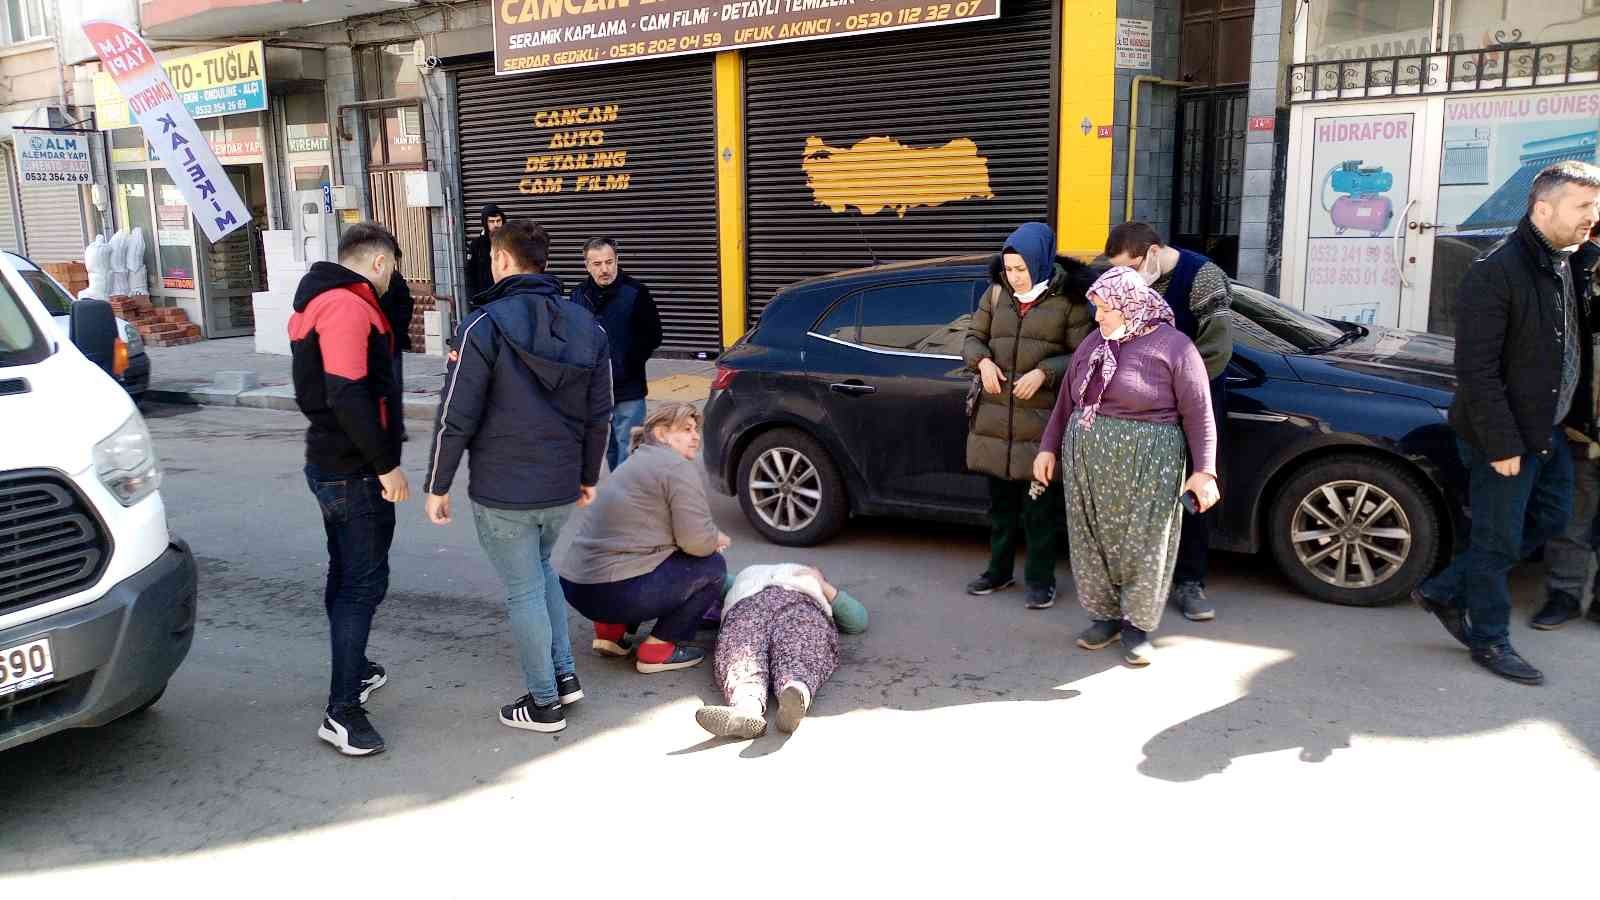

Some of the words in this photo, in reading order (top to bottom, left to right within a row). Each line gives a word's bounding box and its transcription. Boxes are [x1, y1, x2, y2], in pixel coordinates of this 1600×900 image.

[565, 20, 627, 42] KAPLAMA
[639, 13, 669, 31] CAM
[673, 7, 709, 27] FİLMİ
[721, 0, 780, 21] DETAYLI
[783, 0, 854, 13] TEMİZ
[504, 55, 549, 71] SERDAR
[610, 42, 644, 58] 0536
[648, 37, 675, 53] 202
[680, 35, 700, 49] 04
[702, 33, 722, 47] 59
[734, 25, 774, 44] UFUK
[779, 18, 832, 38] AKINCI
[845, 11, 892, 30] 0530
[897, 8, 922, 25] 112
[926, 4, 951, 20] 32
[955, 1, 981, 17] 07
[203, 49, 259, 85] TUĞLA
[534, 104, 619, 128] CANCAN
[1448, 100, 1530, 120] VAKUMLU
[549, 129, 605, 149] AUTO
[1319, 120, 1408, 143] HİDRAFOR
[46, 138, 77, 150] ALM
[22, 151, 65, 160] ALEMDAR
[66, 152, 87, 160] YAPI
[524, 151, 627, 173] DETAILING
[25, 172, 47, 182] 0532
[49, 172, 65, 182] 354
[79, 172, 89, 182] 69
[518, 176, 563, 194] CAM
